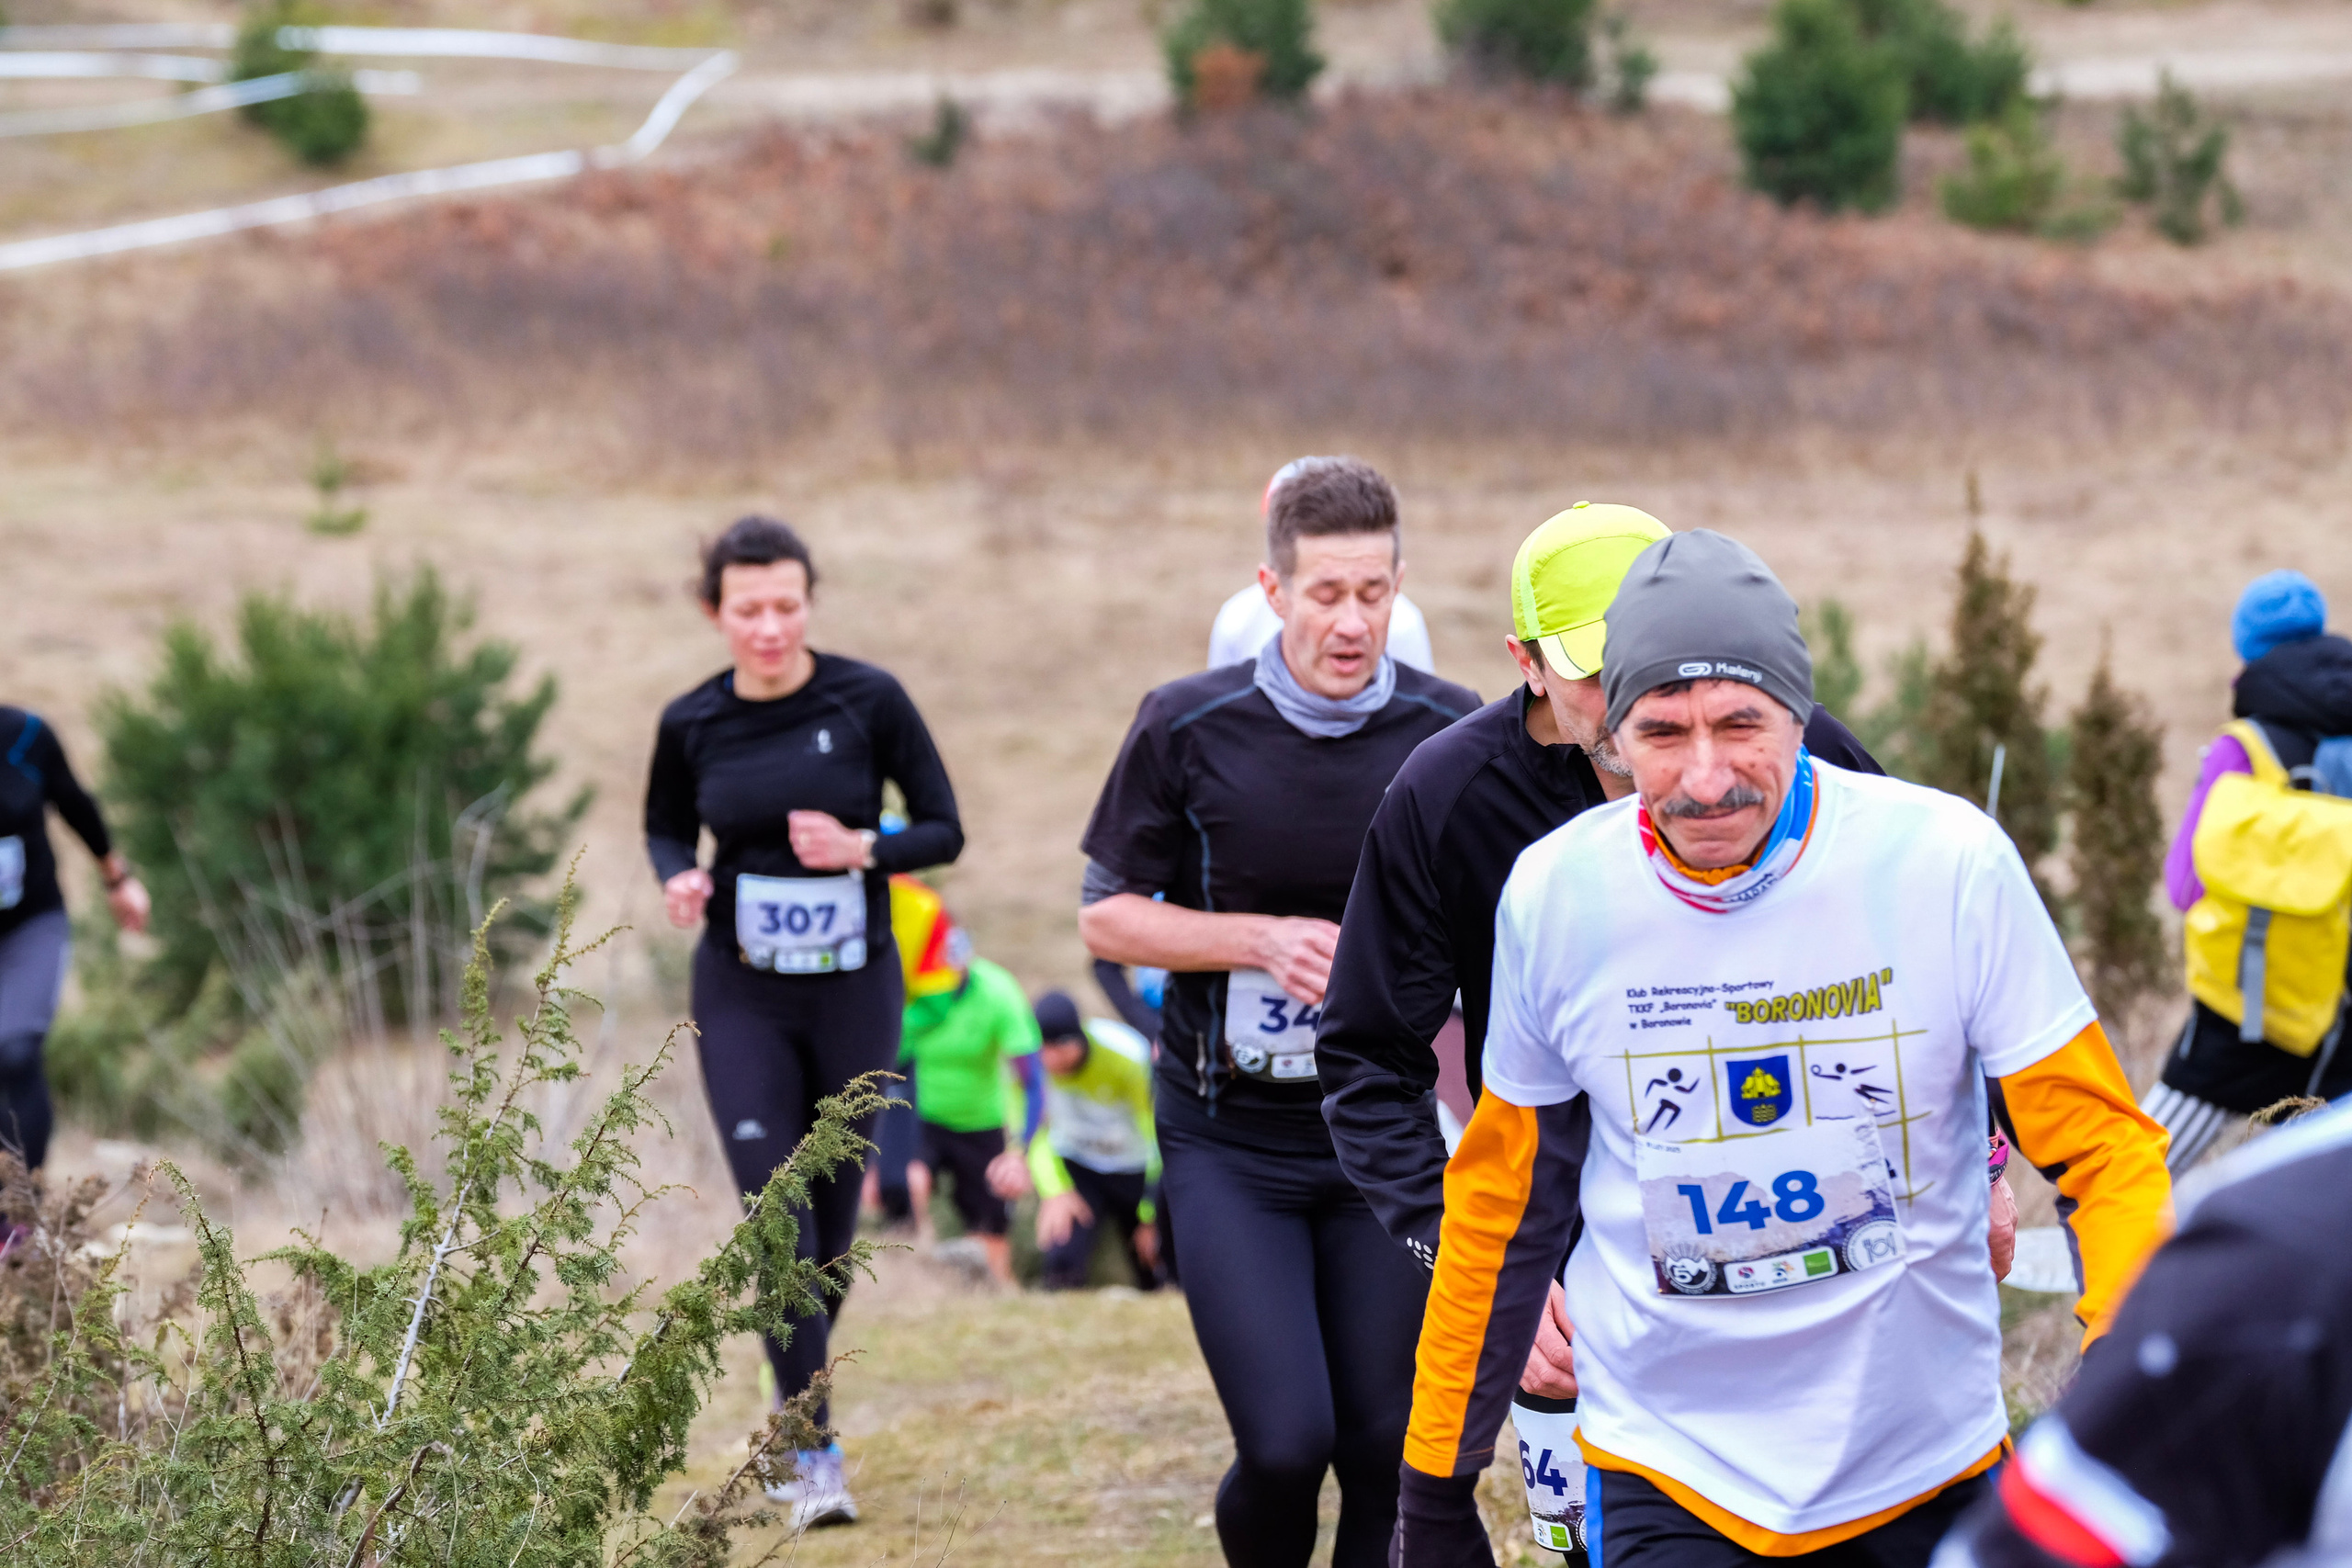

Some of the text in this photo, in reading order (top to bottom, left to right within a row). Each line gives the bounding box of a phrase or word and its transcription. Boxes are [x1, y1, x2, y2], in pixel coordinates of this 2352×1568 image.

[758, 901, 836, 935] 307
[1626, 987, 1647, 998] Klub
[1724, 966, 1893, 1024] "BORONOVIA"
[1629, 1017, 1692, 1030] w Boronowie
[1677, 1169, 1825, 1235] 148
